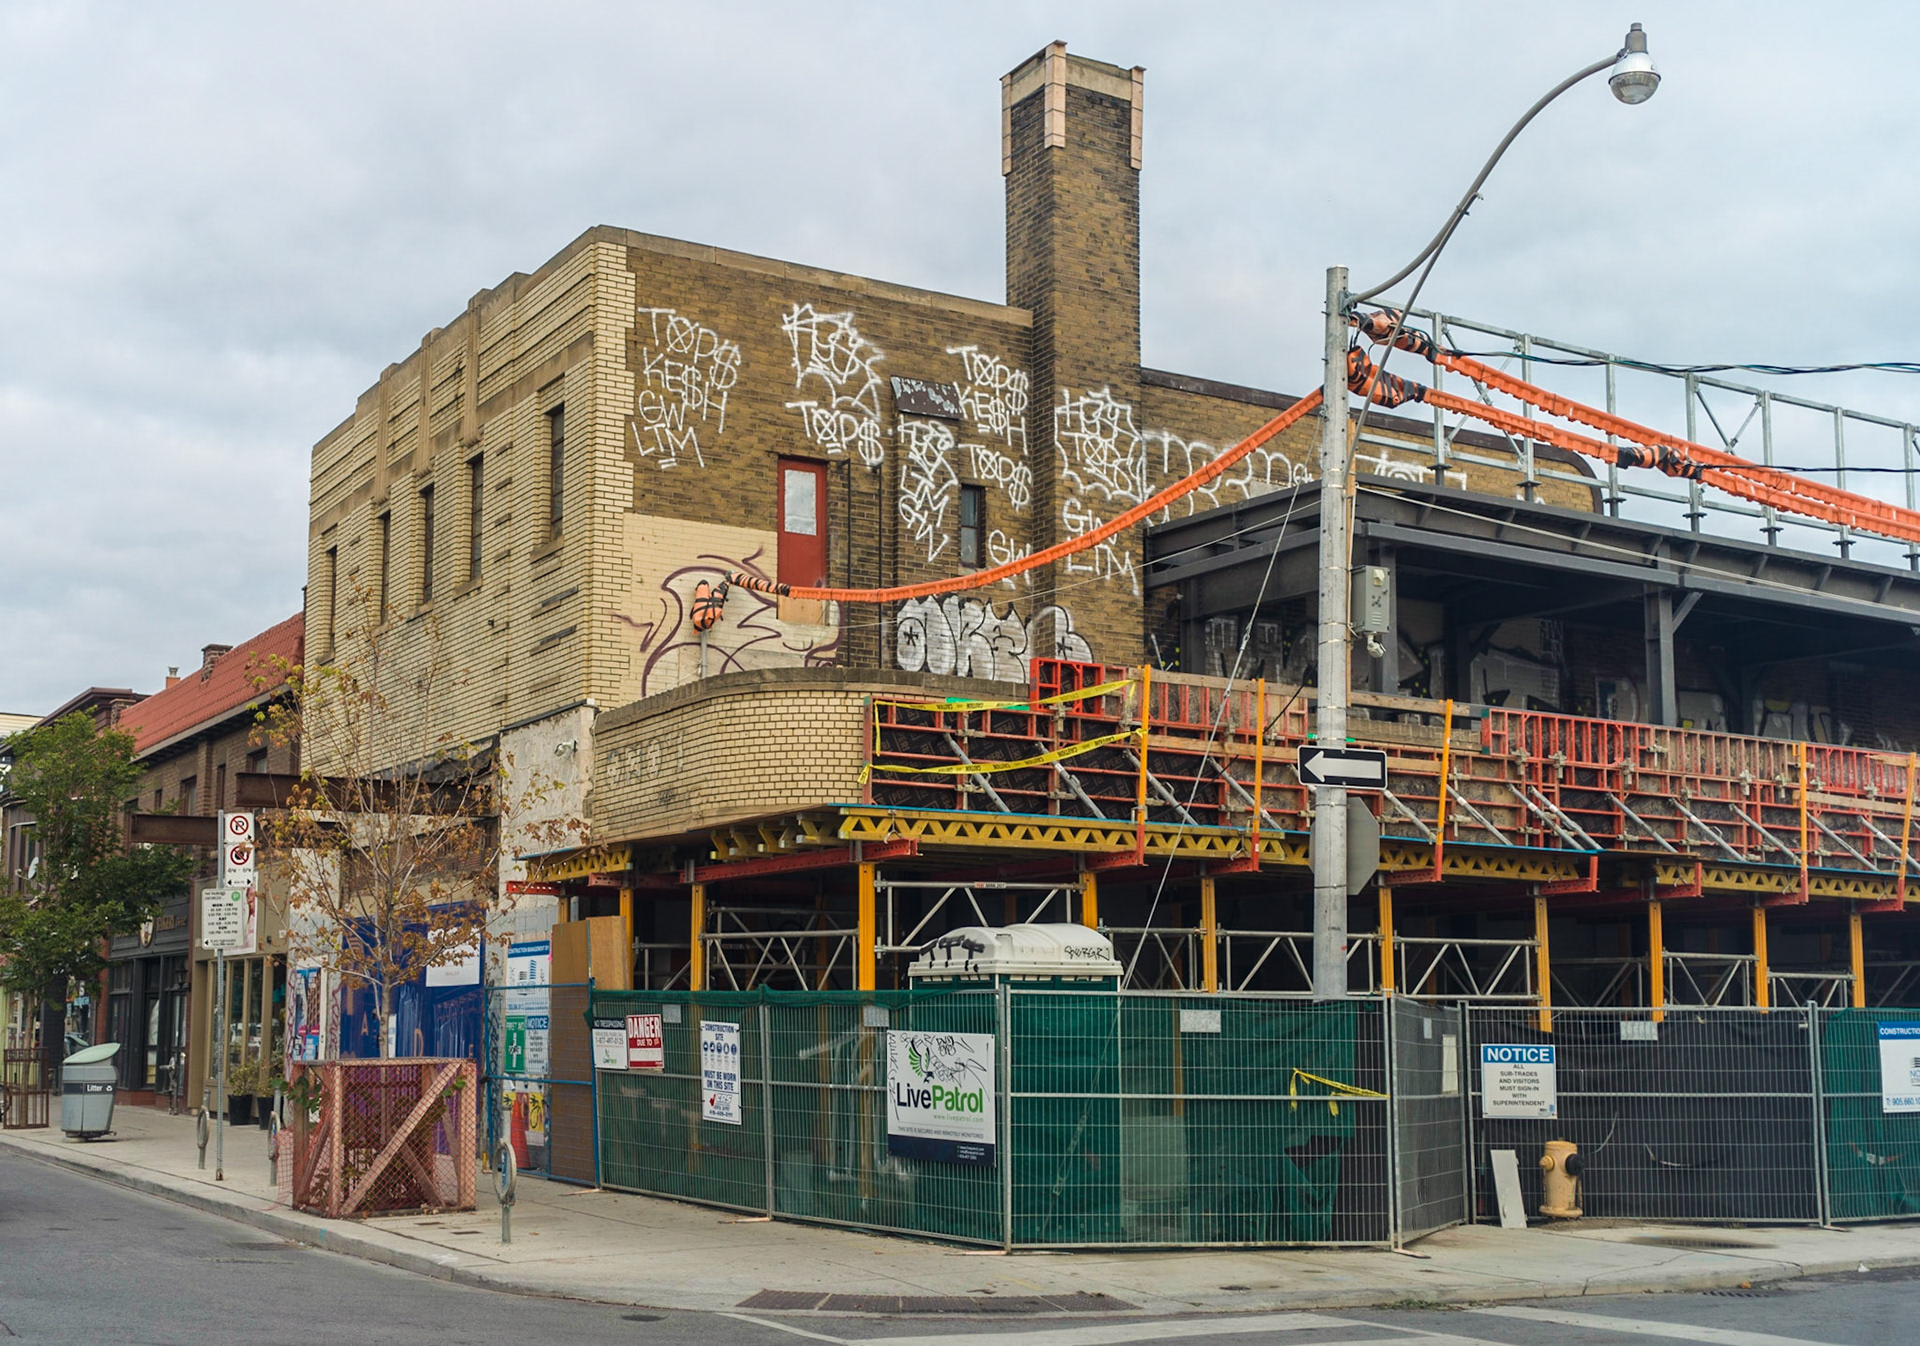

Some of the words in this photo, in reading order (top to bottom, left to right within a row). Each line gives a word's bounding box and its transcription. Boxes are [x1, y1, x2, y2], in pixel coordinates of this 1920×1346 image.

[628, 1016, 661, 1039] DANGER
[704, 1023, 735, 1034] CONSTRUCTION
[715, 1033, 724, 1042] SITE
[1487, 1047, 1550, 1062] NOTICE
[704, 1069, 716, 1079] MUST
[716, 1071, 722, 1080] BE
[723, 1072, 737, 1082] WORN
[86, 1084, 103, 1092] Litter
[706, 1079, 713, 1089] ON
[713, 1080, 723, 1090] THIS
[723, 1081, 734, 1091] SITE
[896, 1082, 984, 1113] LivePatrol
